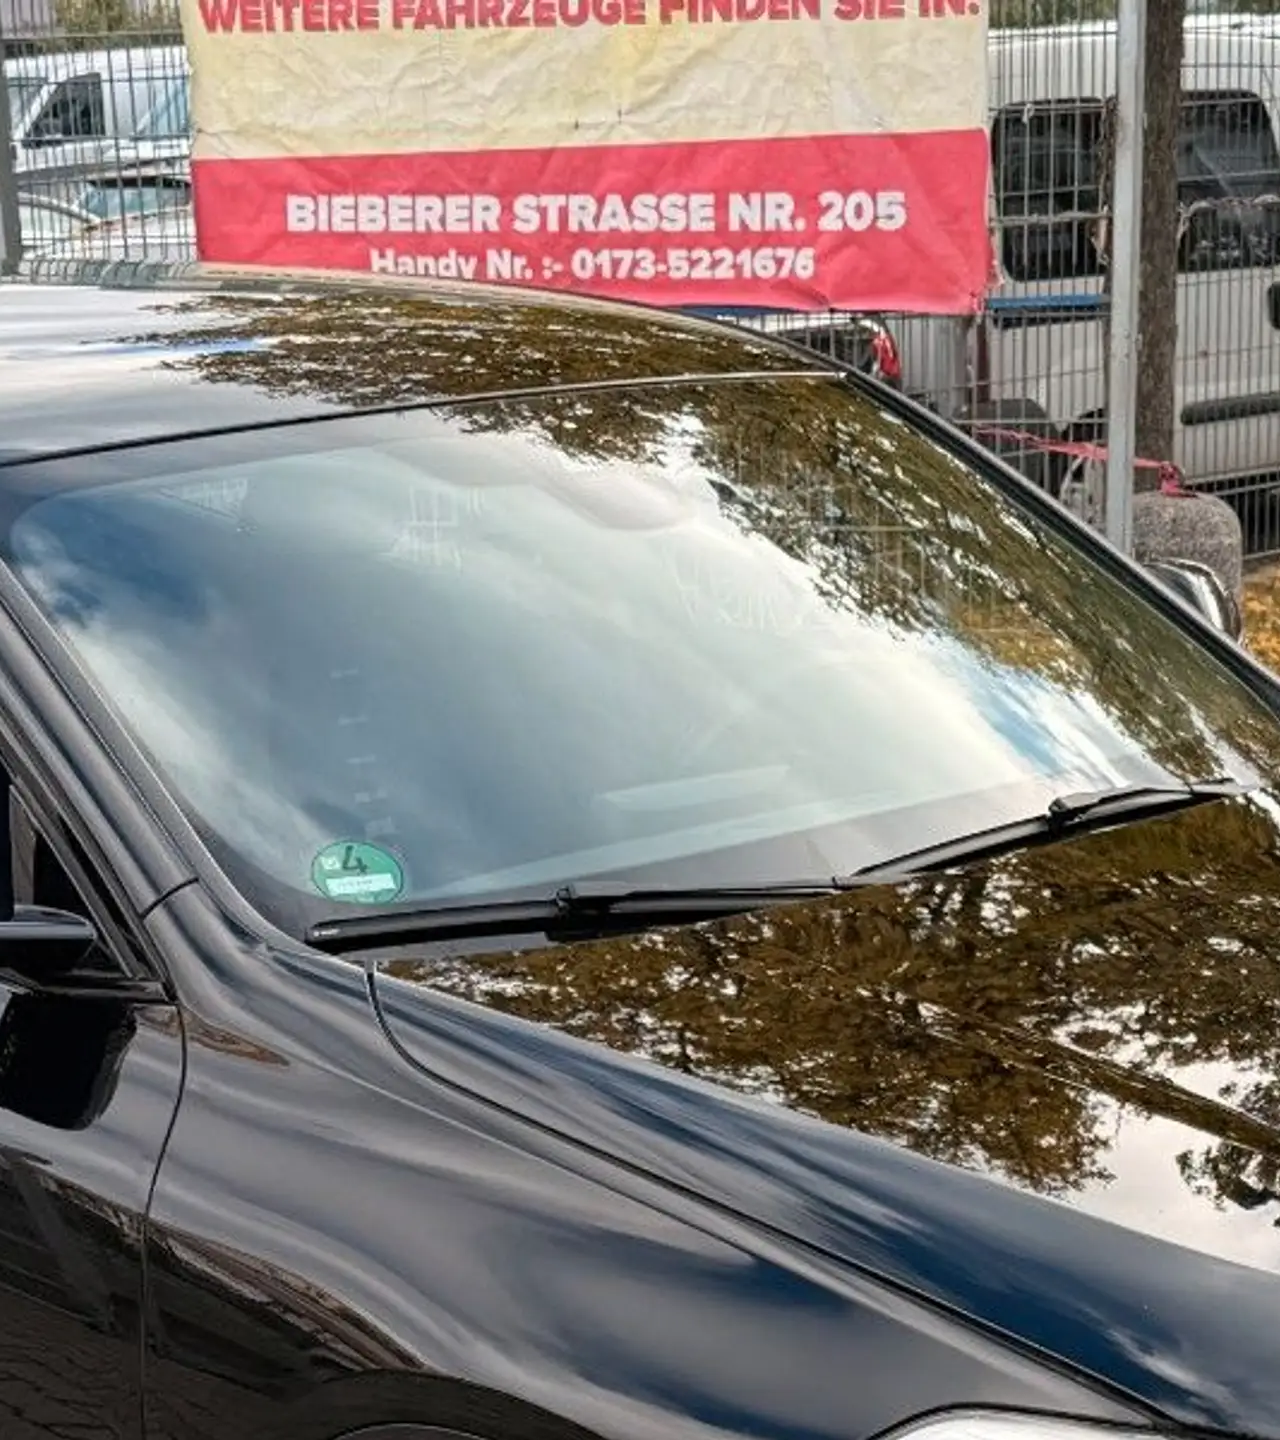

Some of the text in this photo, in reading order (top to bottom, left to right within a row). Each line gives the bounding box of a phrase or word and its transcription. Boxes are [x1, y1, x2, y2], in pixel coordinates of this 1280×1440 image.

[286, 191, 907, 232] BIEBERER STRASSE NR. 205
[571, 248, 816, 280] 0173-5221676
